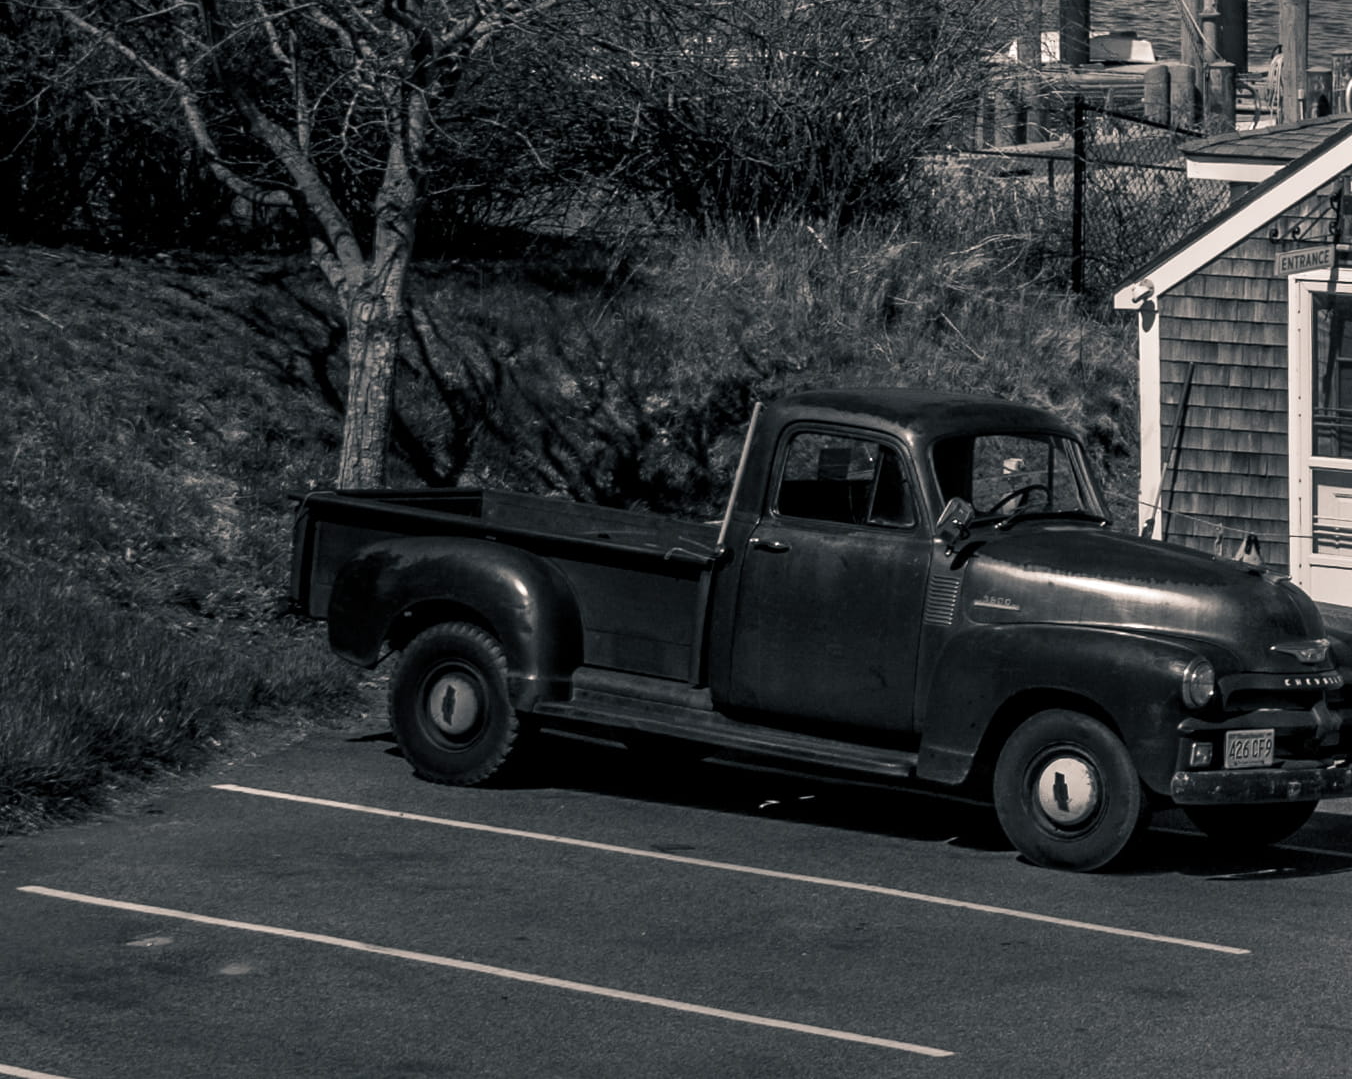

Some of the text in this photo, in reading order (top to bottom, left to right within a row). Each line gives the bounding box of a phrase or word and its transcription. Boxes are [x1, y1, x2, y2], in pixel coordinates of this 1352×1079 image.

[1281, 249, 1330, 271] ENTRANCE
[1229, 738, 1273, 760] 426 CF9
